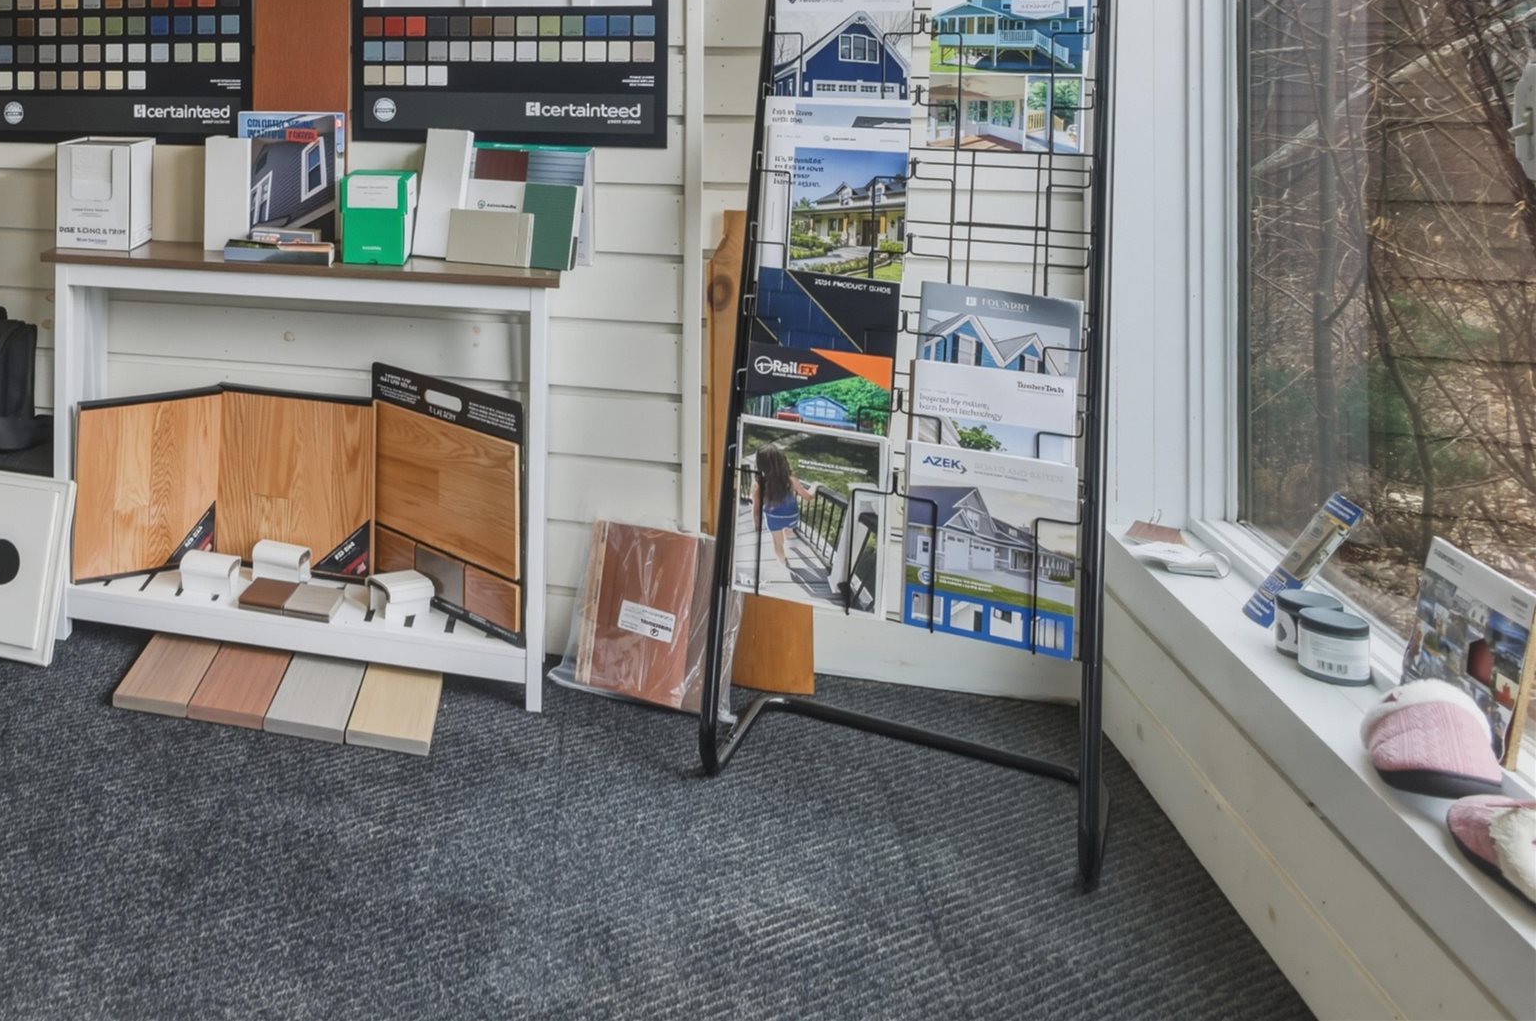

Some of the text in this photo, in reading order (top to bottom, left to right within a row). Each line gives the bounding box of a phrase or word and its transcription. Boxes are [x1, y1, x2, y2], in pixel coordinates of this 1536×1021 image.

[146, 104, 231, 118] certainteed
[541, 102, 642, 118] certainteed
[832, 281, 867, 291] PRODUCT
[922, 455, 961, 469] AZEK
